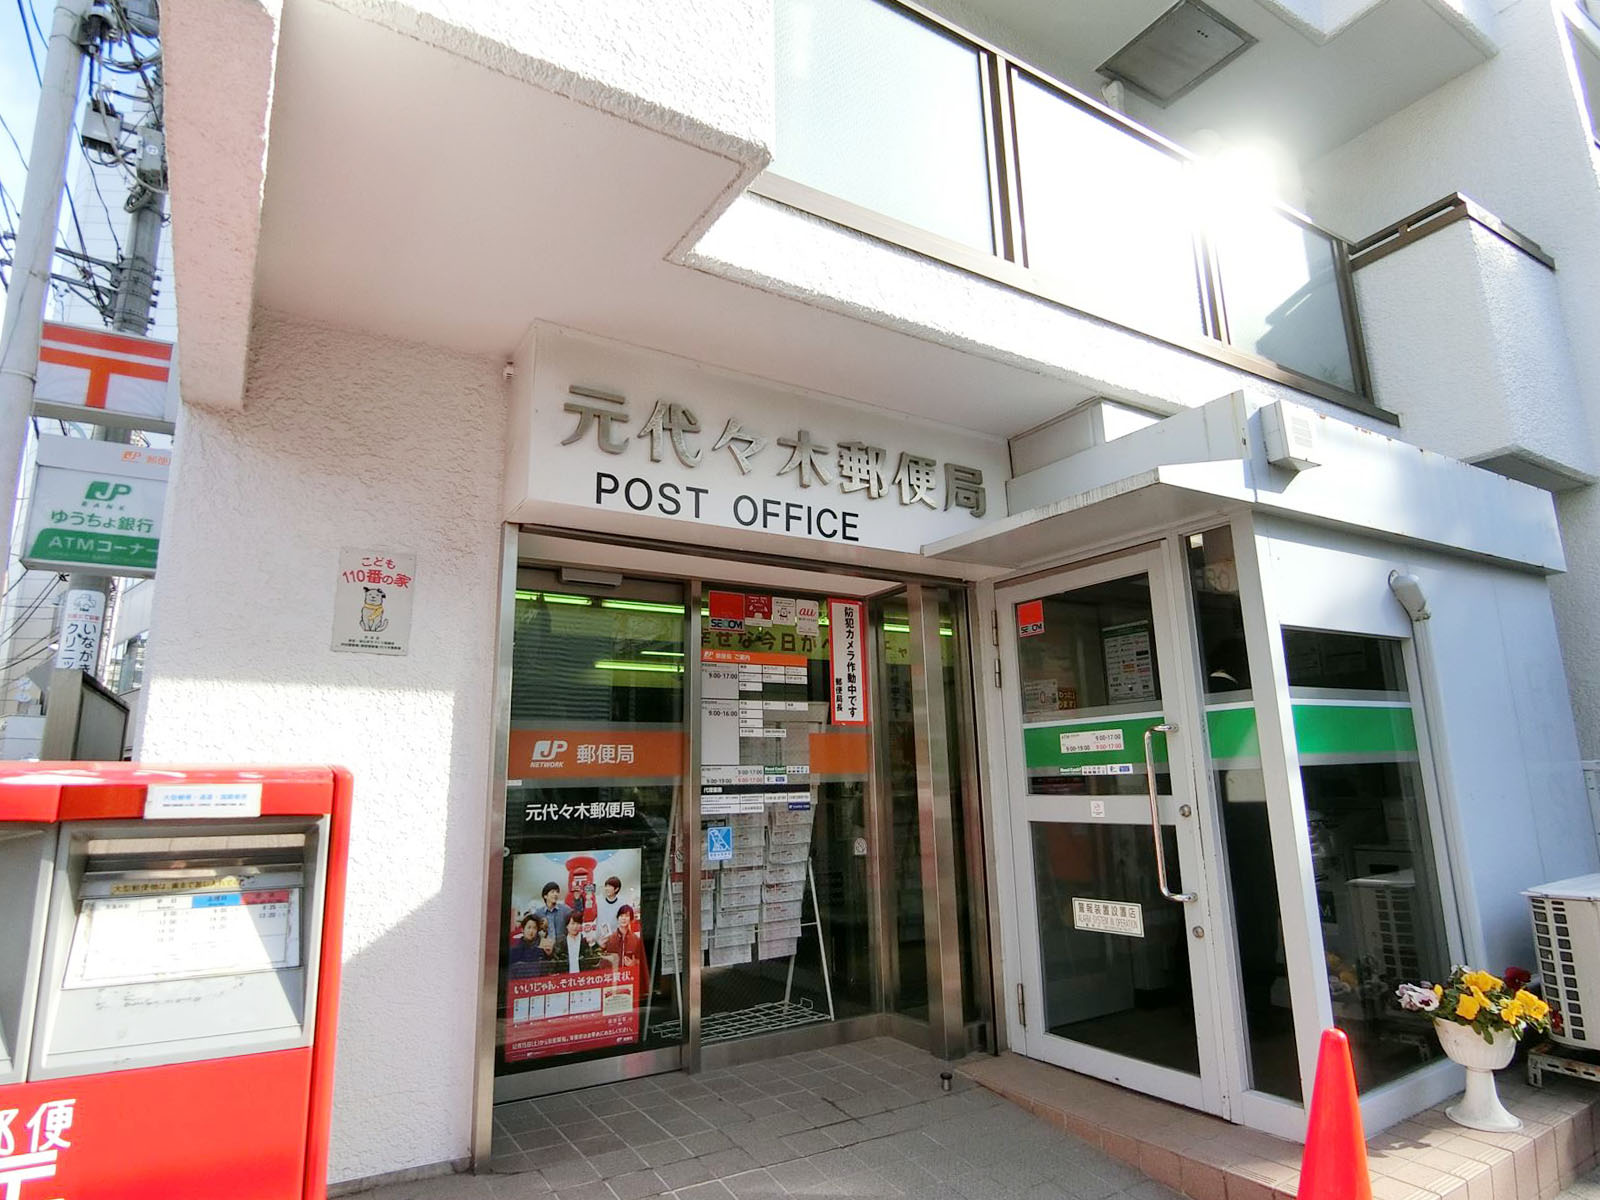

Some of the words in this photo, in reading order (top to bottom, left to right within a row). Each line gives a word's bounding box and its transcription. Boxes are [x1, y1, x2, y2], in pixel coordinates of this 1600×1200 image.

[146, 454, 171, 466] 郵便
[561, 384, 987, 518] 元代々木郵便局
[85, 481, 132, 501] JP
[596, 471, 709, 519] POST
[733, 495, 859, 542] OFFICE
[50, 510, 154, 533] ゆうちょ銀行
[361, 556, 396, 570] こども
[342, 569, 412, 588] 110番の家
[799, 607, 816, 617] au
[844, 606, 857, 718] 防犯カメラ作動中です
[835, 677, 843, 712] 郵便局長
[531, 740, 568, 761] JP
[576, 744, 635, 764] 郵便局
[525, 801, 636, 822] 元代々木郵便局
